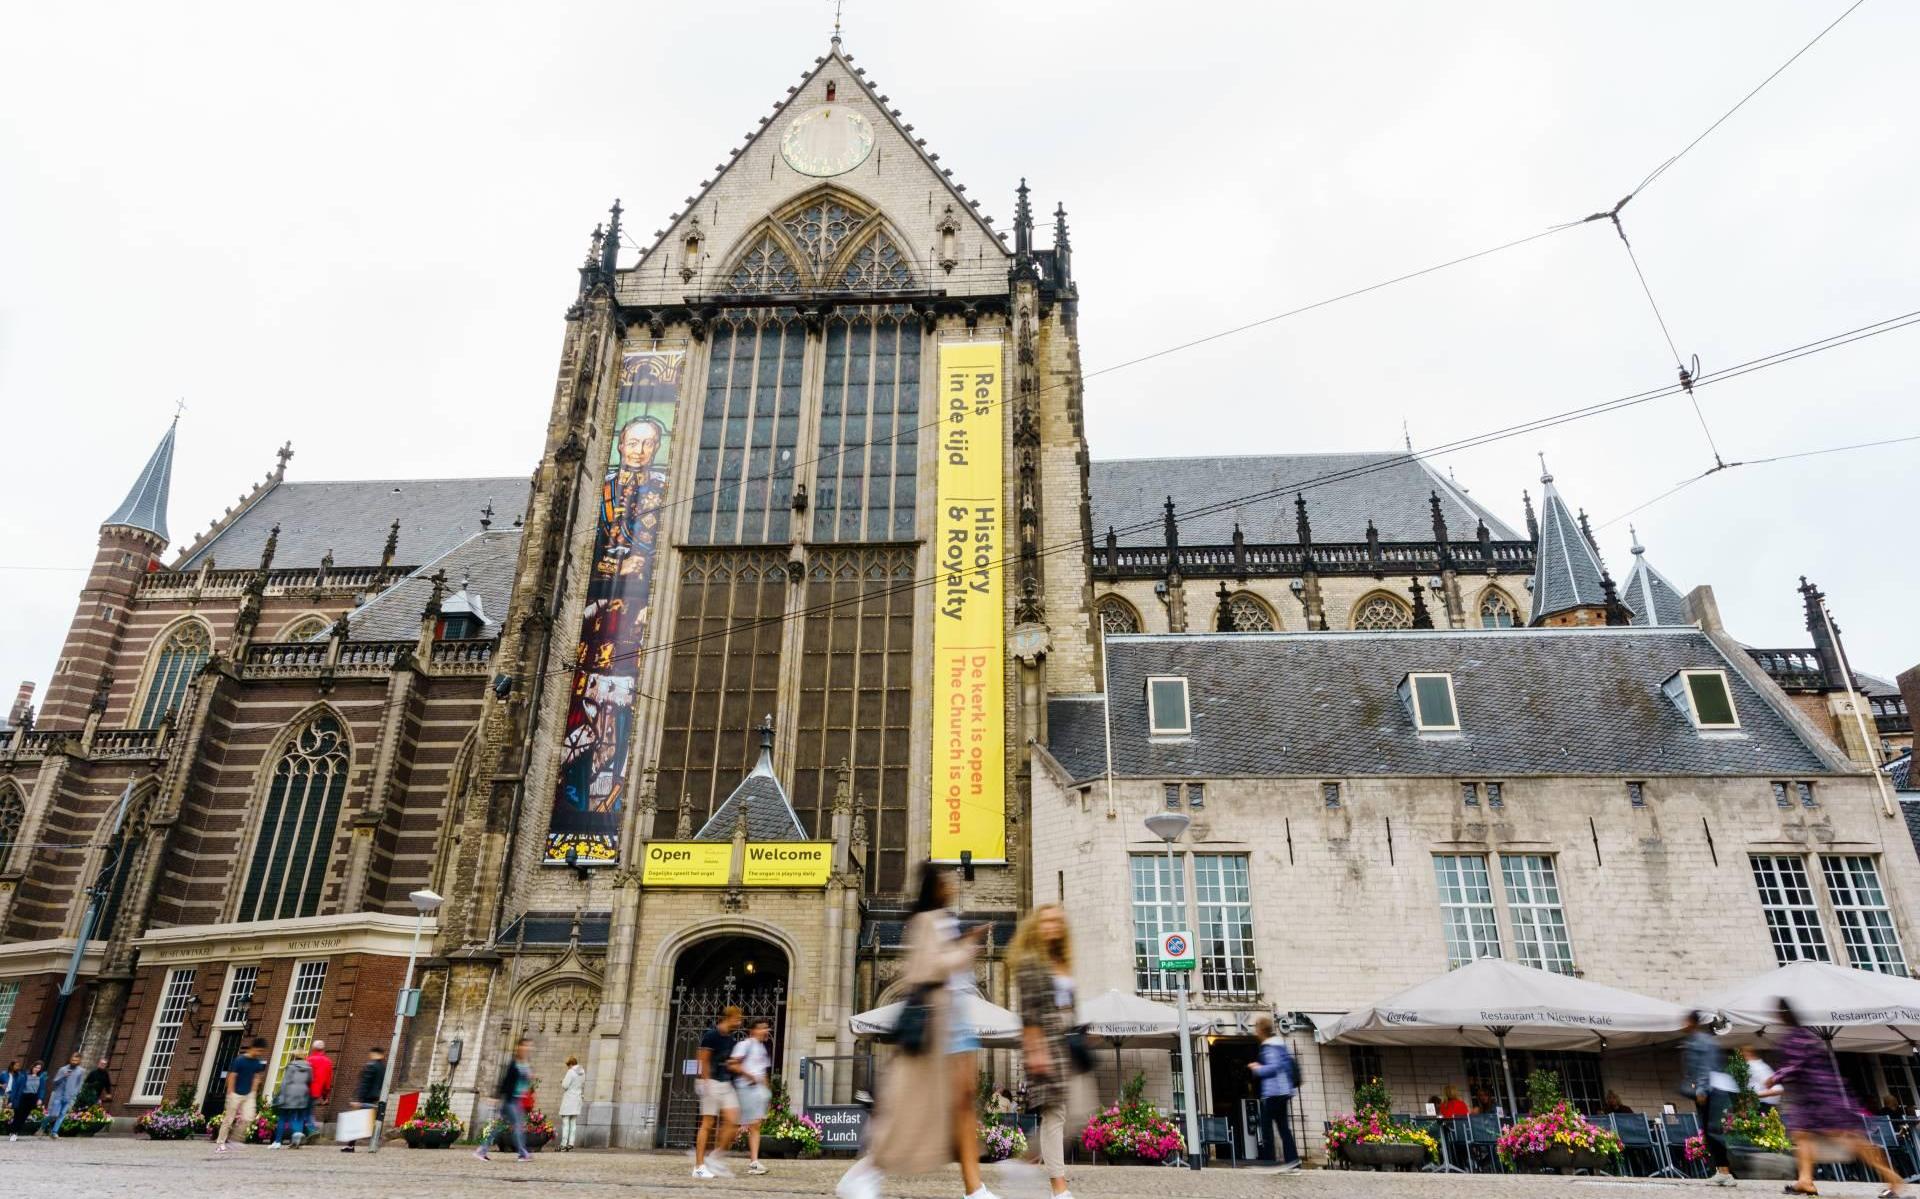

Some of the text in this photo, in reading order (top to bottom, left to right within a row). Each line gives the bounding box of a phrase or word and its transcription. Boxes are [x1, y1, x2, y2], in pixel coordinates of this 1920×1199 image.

[975, 373, 994, 416] Reis
[944, 373, 968, 466] in de tijd
[970, 507, 994, 594] History
[942, 505, 968, 621] & Royalty
[968, 655, 986, 795] De kerk is open
[946, 656, 966, 835] The Church is open
[650, 847, 691, 863] Open
[749, 848, 822, 860] Welcome
[288, 938, 341, 949] MUSEUM SHOP
[1387, 1011, 1418, 1024] Coca-Cola
[1480, 1011, 1535, 1021] Restaurant
[1547, 1012, 1586, 1023] Nieuwe
[1831, 1011, 1889, 1021] Restaurant
[1105, 1023, 1137, 1033] Nieuwe
[814, 1111, 861, 1124] Breakfast
[827, 1129, 857, 1141] Lunch
